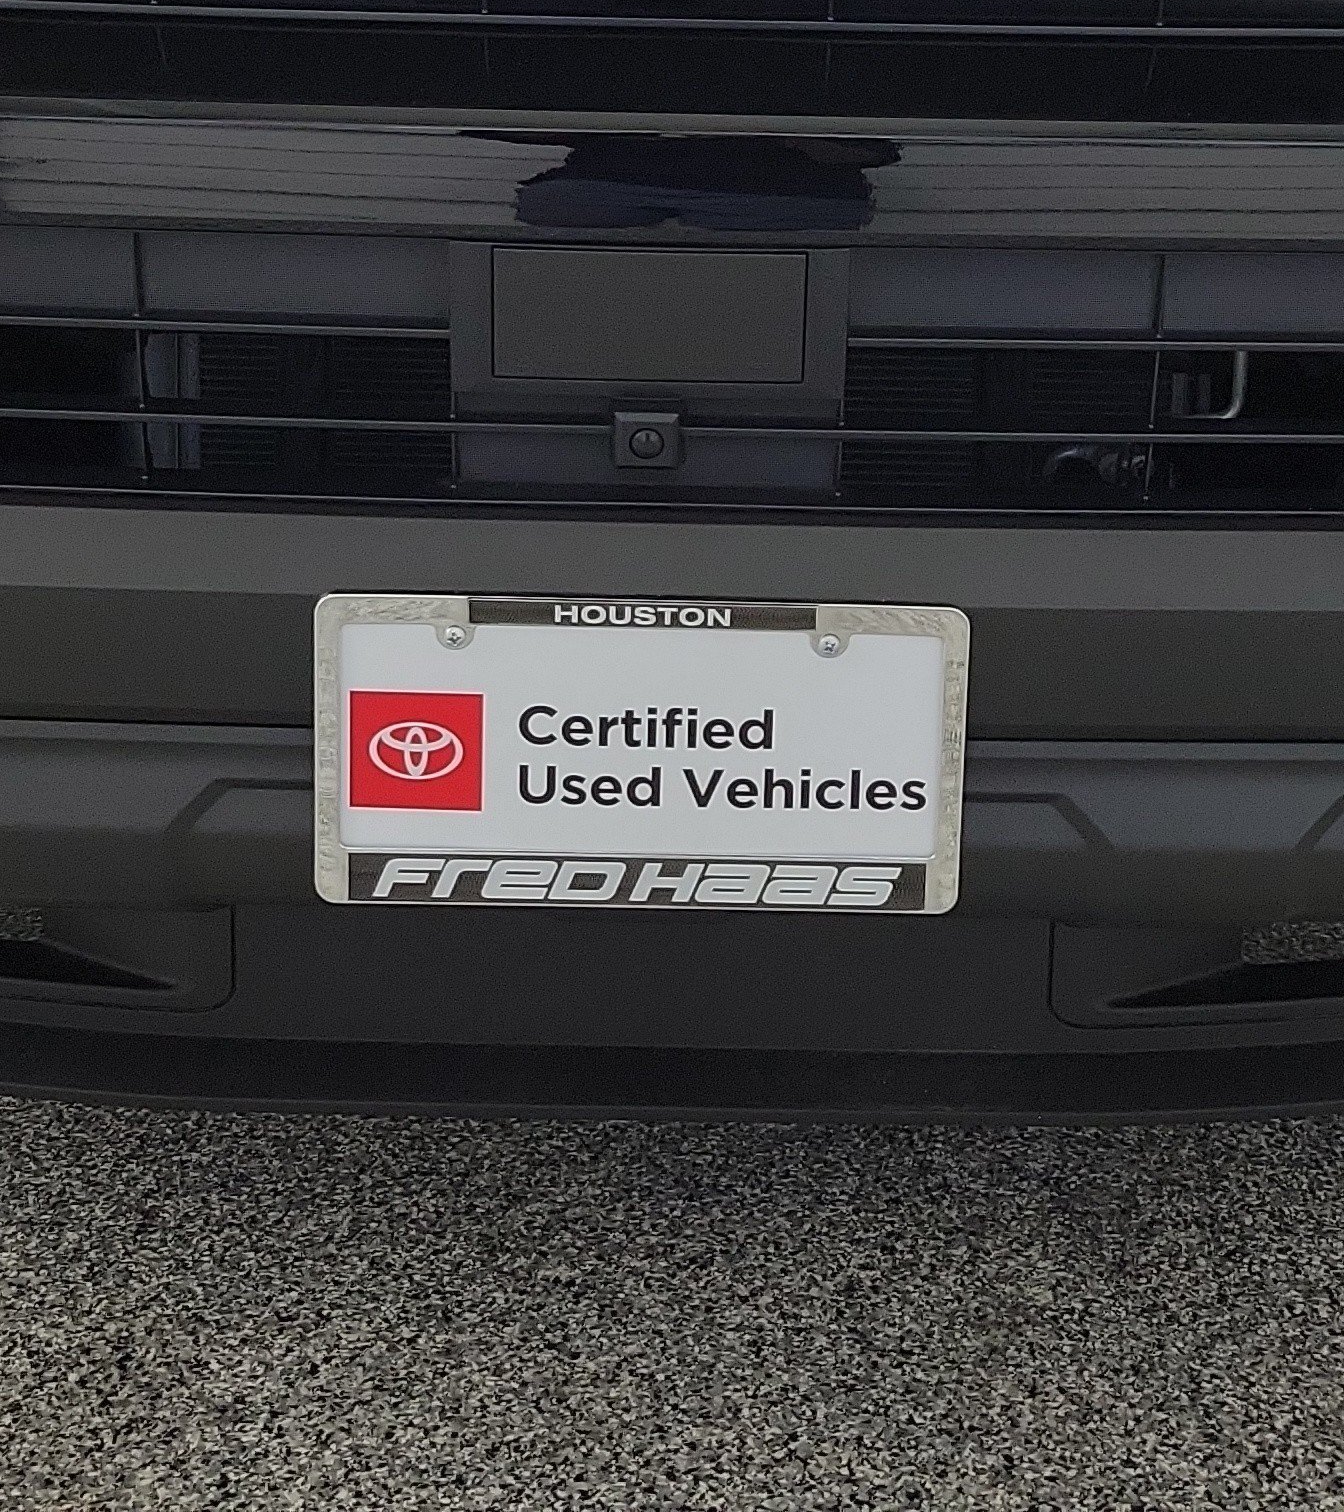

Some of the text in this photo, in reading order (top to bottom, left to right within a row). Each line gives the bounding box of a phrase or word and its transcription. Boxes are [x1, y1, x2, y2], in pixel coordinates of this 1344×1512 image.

[553, 604, 732, 627] HOUSTON
[518, 705, 775, 750] Certified
[519, 764, 927, 811] Used Vehicles
